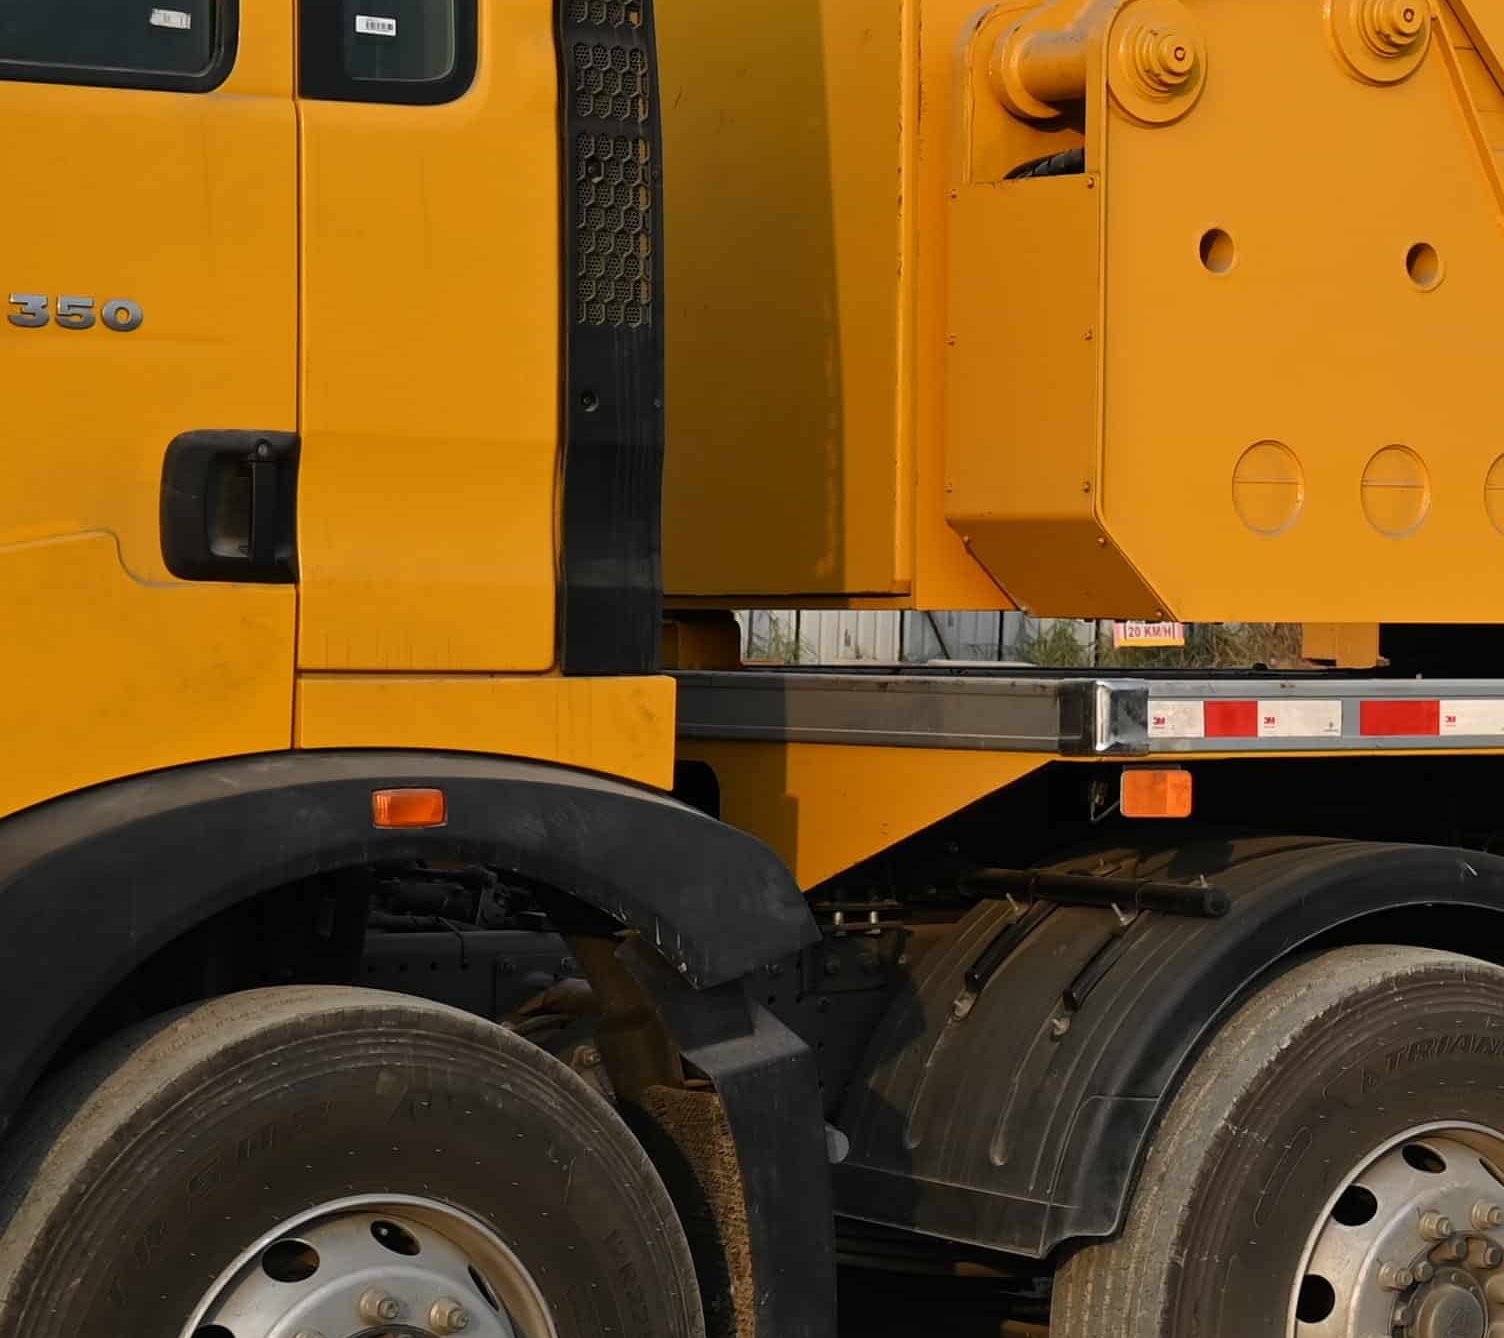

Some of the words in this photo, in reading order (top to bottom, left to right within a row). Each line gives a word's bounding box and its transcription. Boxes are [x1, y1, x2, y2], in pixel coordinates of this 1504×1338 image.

[7, 292, 144, 331] 350
[1152, 717, 1165, 726] 3M
[1264, 717, 1276, 726] 3M
